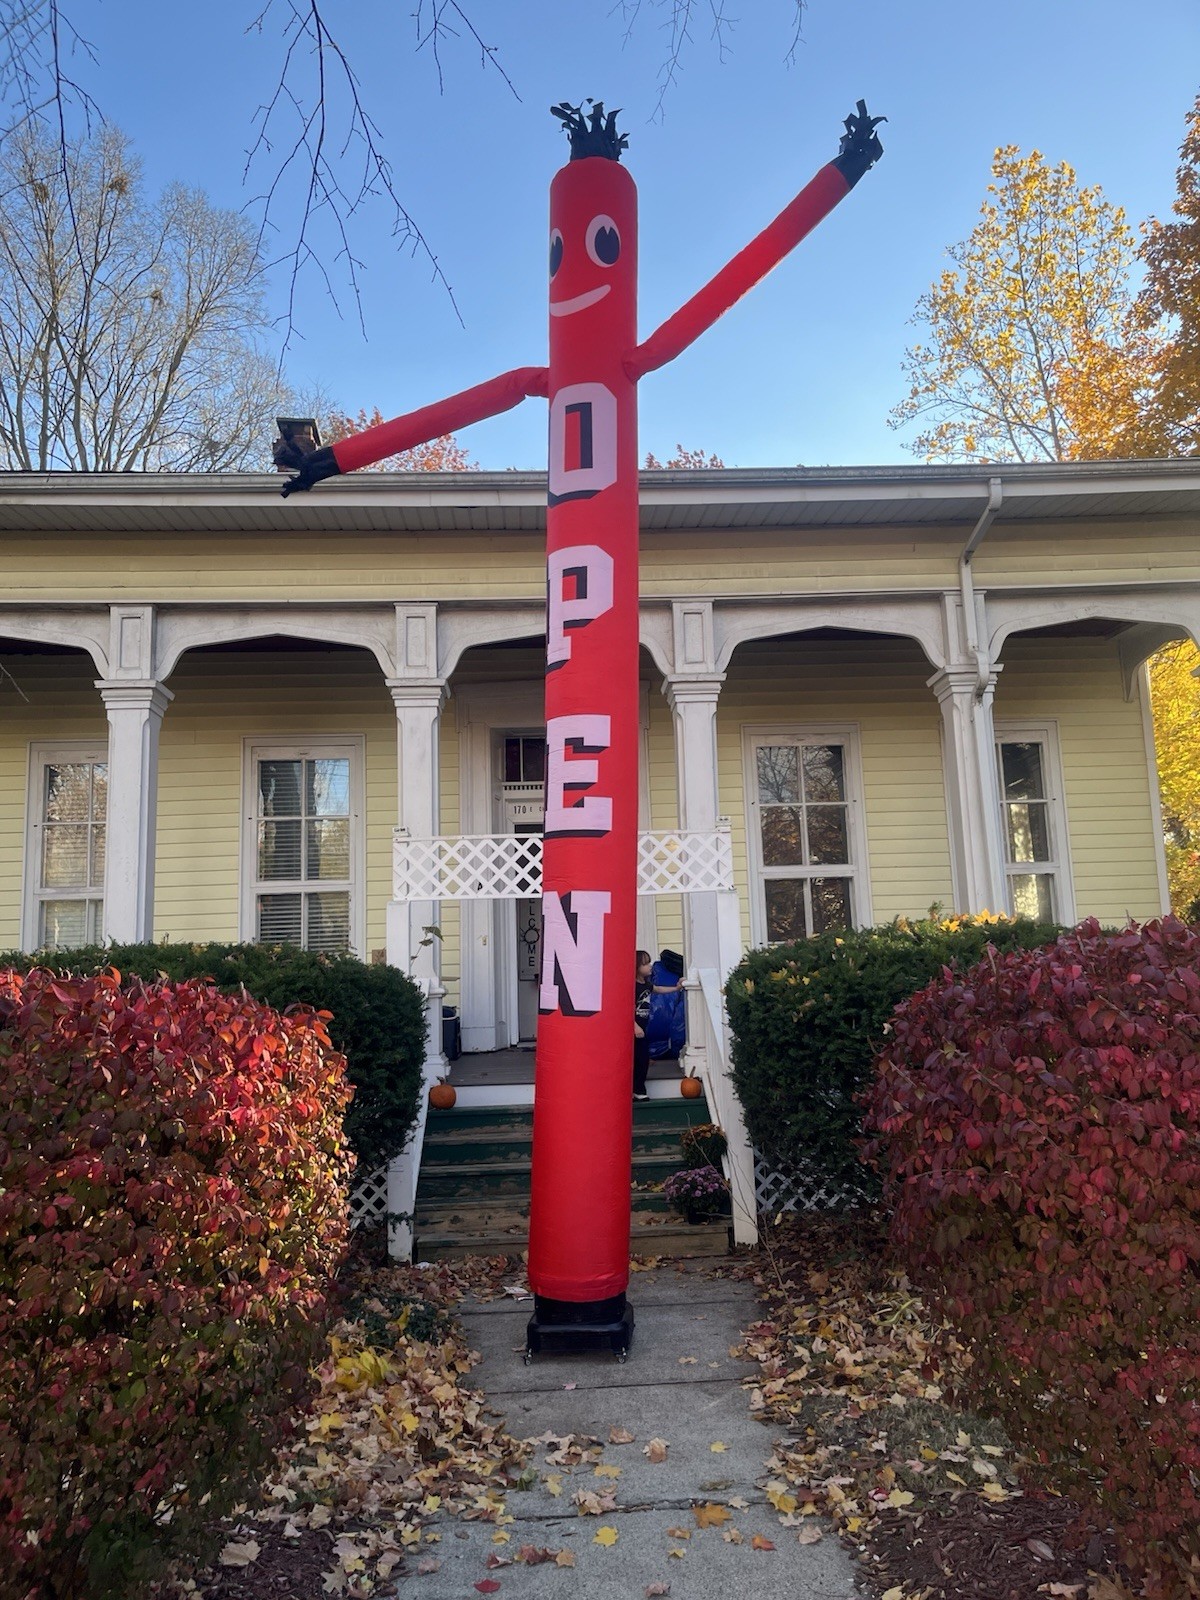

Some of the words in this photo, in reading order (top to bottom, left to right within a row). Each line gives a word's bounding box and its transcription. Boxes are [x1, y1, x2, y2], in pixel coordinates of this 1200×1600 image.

[540, 382, 617, 1016] OPEN
[513, 805, 527, 815] 170
[523, 898, 540, 967] ELCOME
